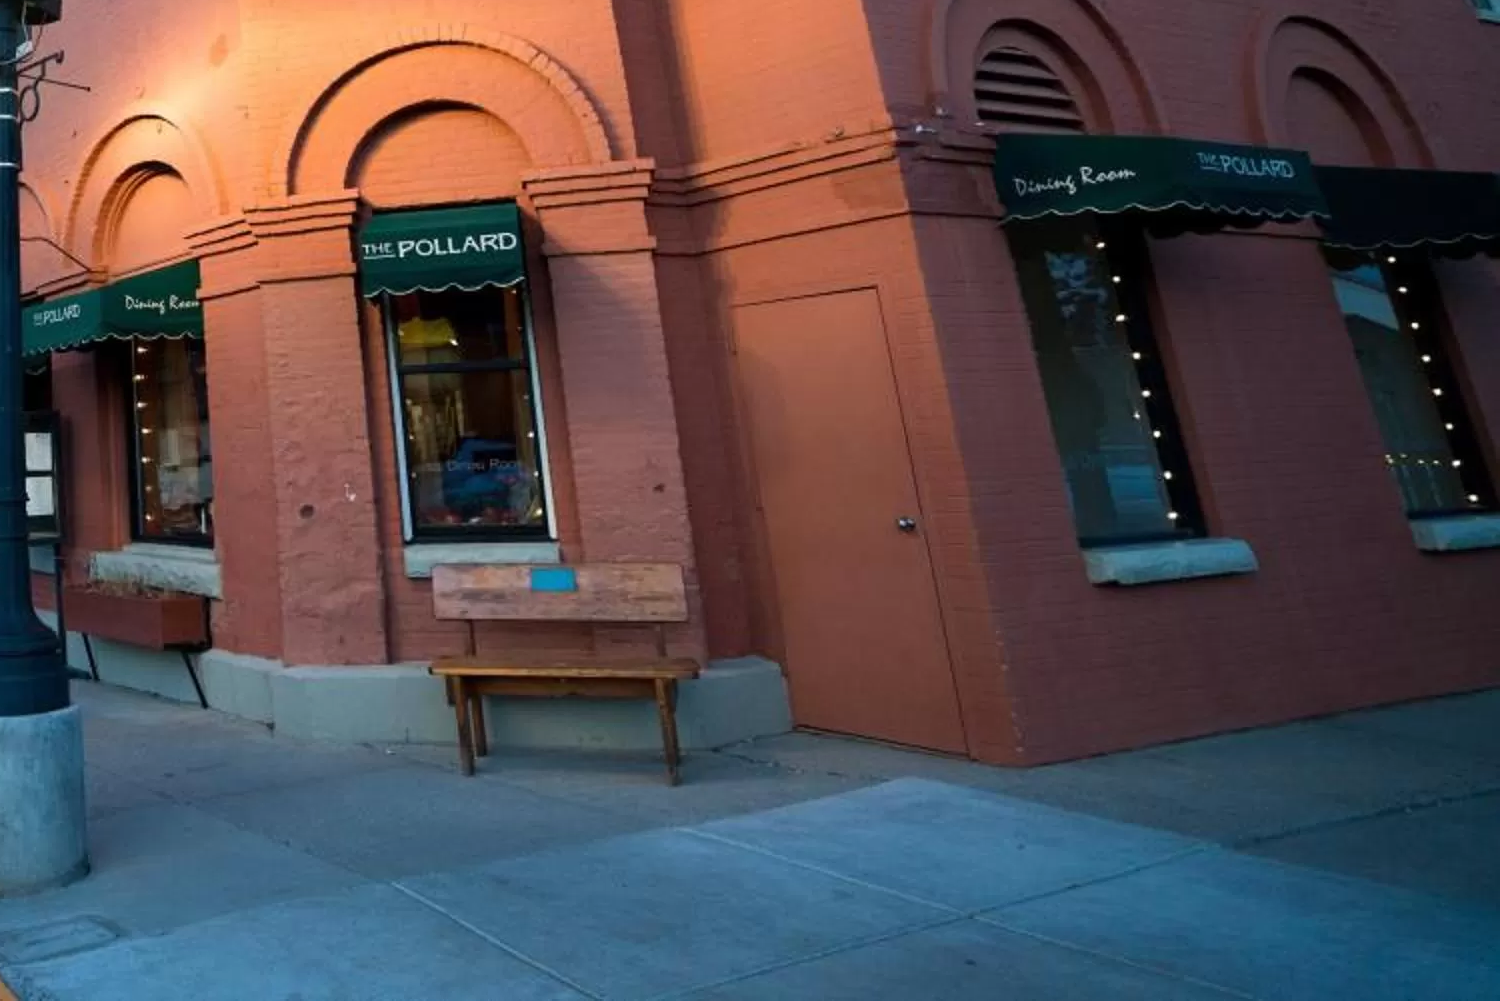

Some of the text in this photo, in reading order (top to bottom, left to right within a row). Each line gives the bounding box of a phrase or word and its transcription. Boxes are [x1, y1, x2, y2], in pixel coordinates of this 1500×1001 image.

[1196, 151, 1296, 179] THE POLLARD
[1012, 165, 1137, 196] Dining Room
[361, 232, 518, 259] THE POLLARD
[43, 304, 81, 325] POLLARD
[125, 295, 165, 315] Dining
